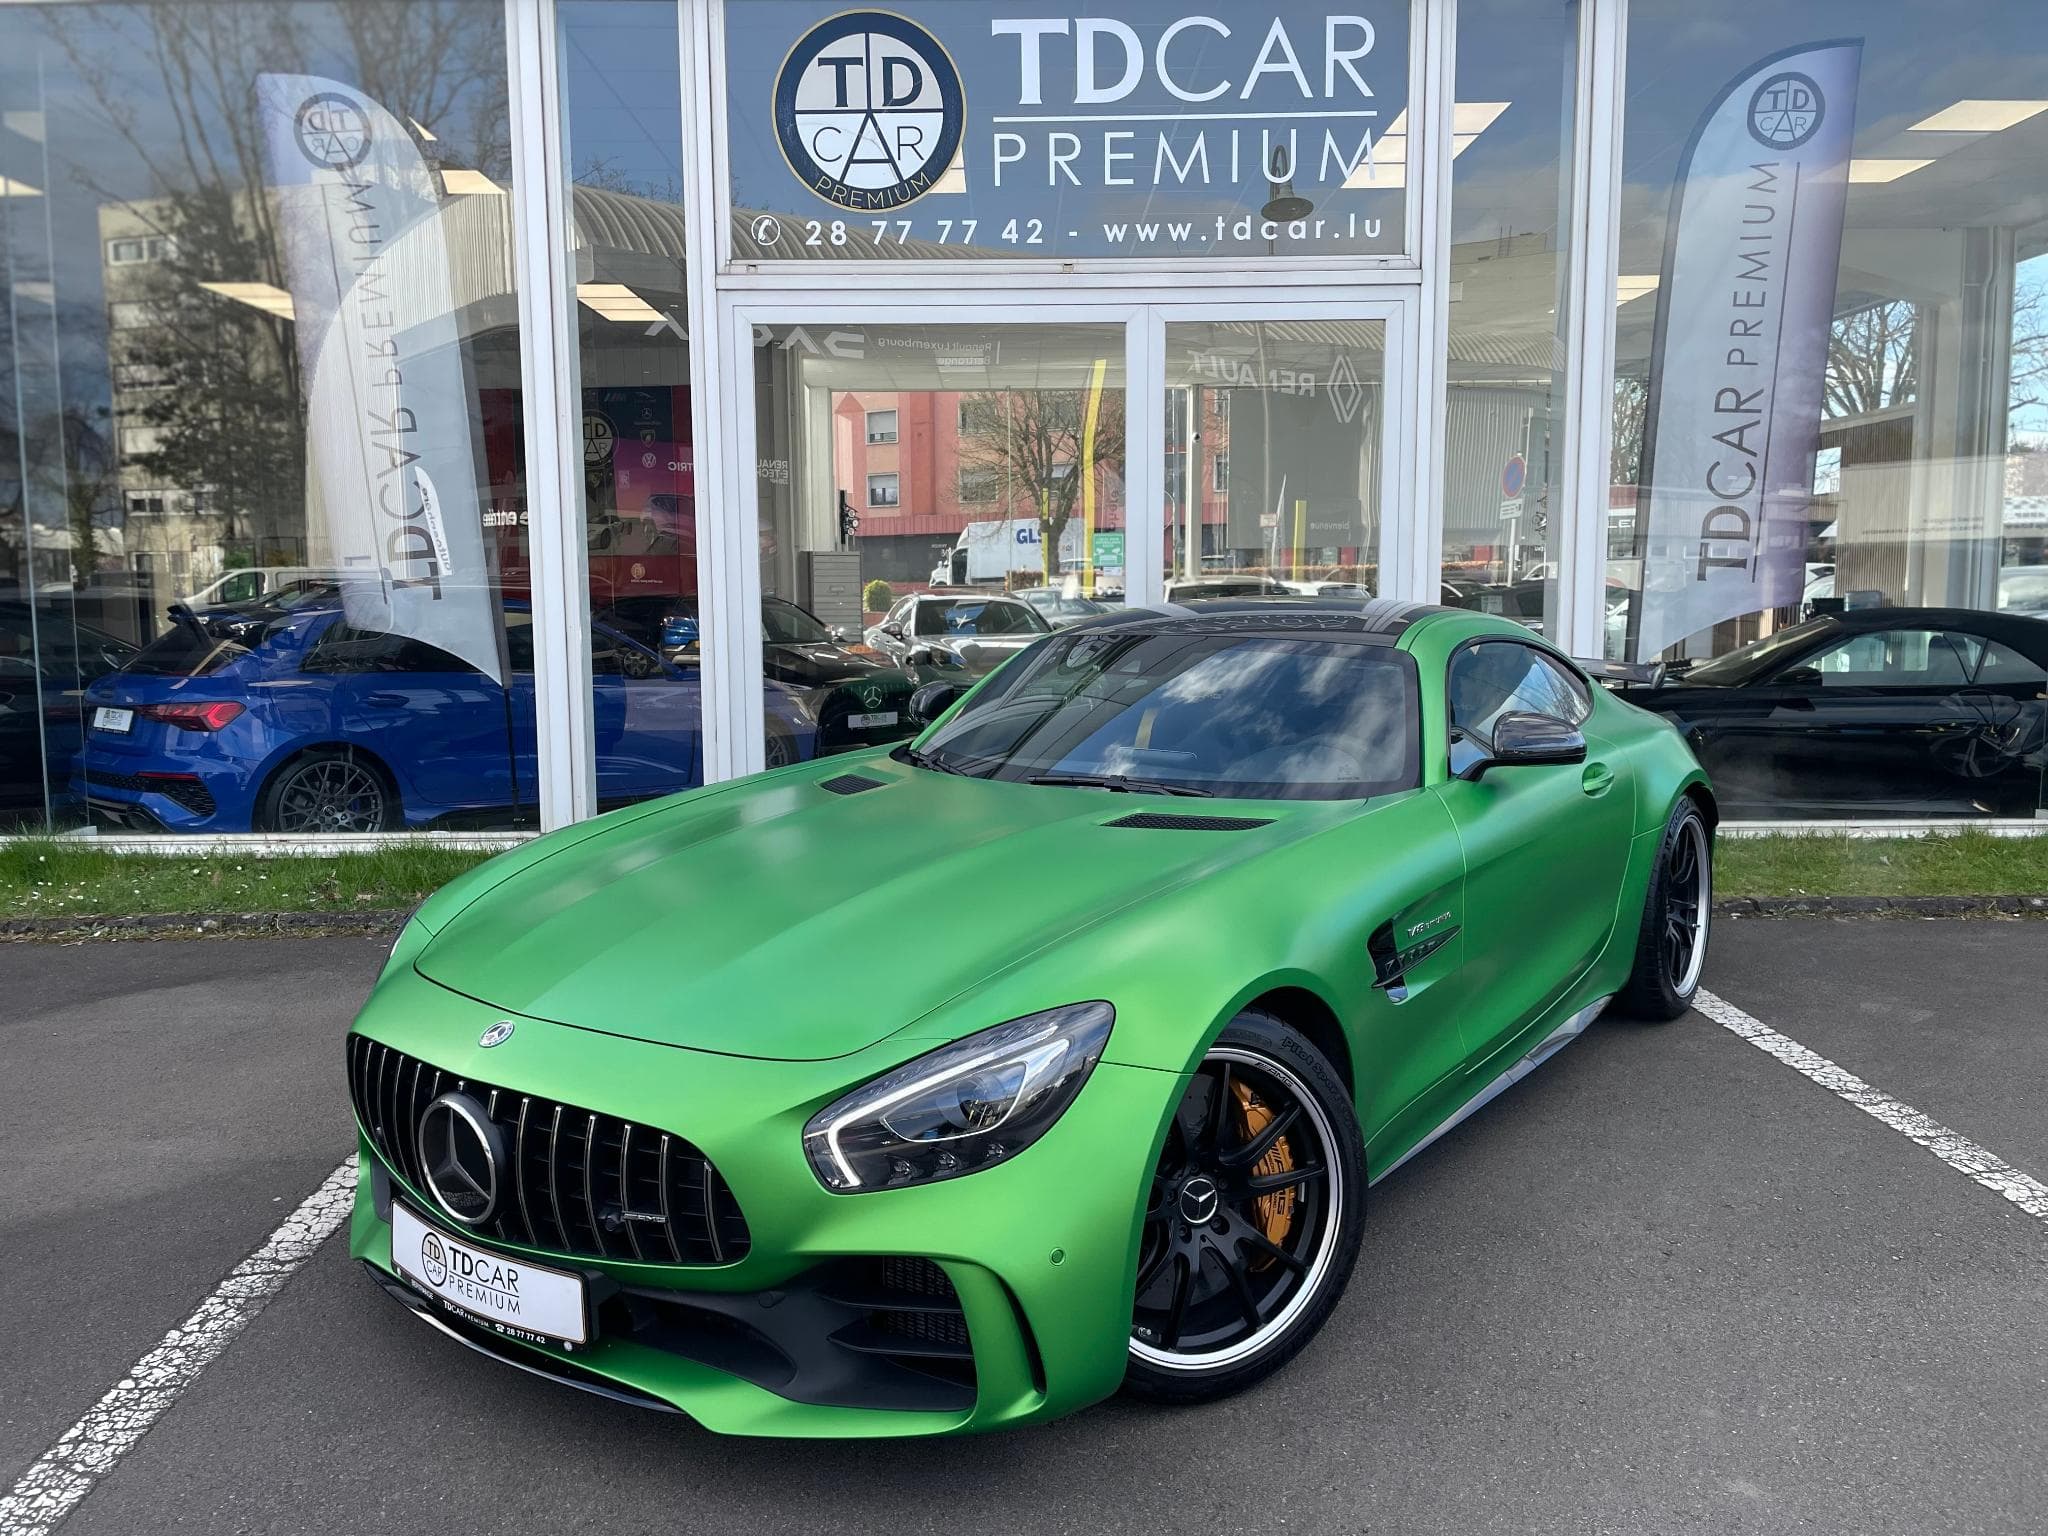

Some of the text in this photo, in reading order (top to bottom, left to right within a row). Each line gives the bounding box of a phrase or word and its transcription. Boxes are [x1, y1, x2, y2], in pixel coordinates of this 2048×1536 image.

[991, 15, 1375, 105] TDCAR
[813, 112, 925, 182] CAR
[993, 128, 1376, 187] PREMIUM
[815, 171, 932, 209] PREMIUM
[805, 220, 847, 245] 28
[872, 221, 913, 245] 77
[937, 220, 978, 244] 77
[1001, 219, 1043, 244] 42
[1103, 213, 1381, 243] www.tdcar.lu
[1697, 162, 1780, 582] TDCAR PREMIUM
[426, 1260, 442, 1280] CAR
[427, 1239, 441, 1260] TD
[449, 1245, 519, 1293] TDCAR
[449, 1275, 521, 1316] PREMIUM
